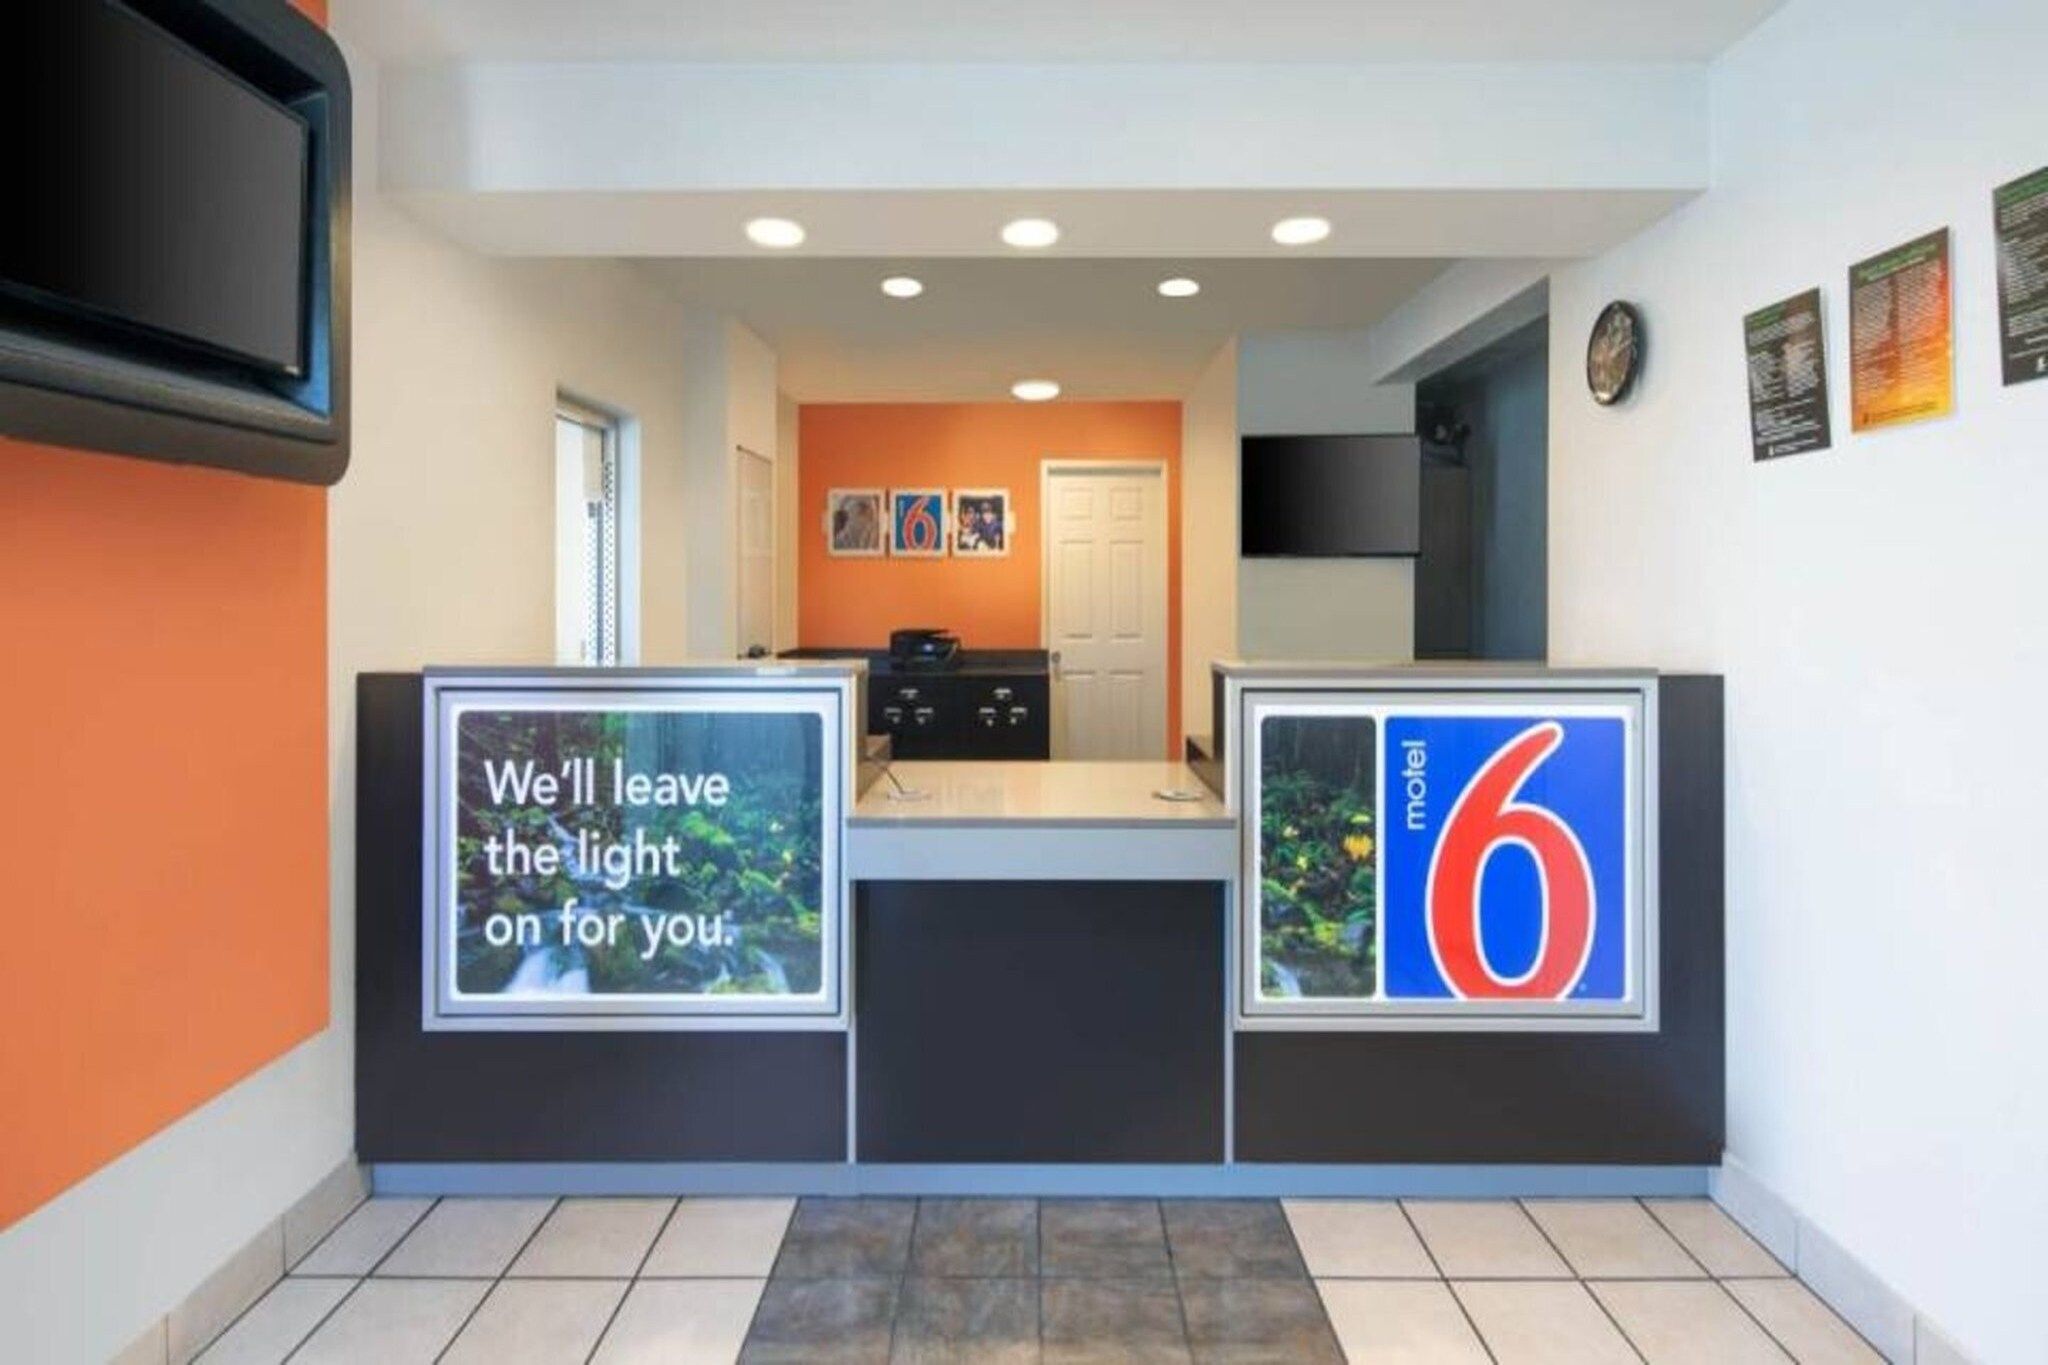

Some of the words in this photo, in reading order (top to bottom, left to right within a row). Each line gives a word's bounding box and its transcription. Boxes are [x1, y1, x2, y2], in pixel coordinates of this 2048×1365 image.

[905, 497, 936, 551] 6
[484, 758, 595, 805] We'll
[613, 758, 730, 805] leave
[1402, 740, 1427, 830] motel
[484, 828, 560, 876] the
[578, 828, 681, 889] light
[1425, 721, 1597, 1000] 6
[484, 911, 540, 947] on
[560, 899, 626, 946] for
[639, 910, 734, 959] you.
